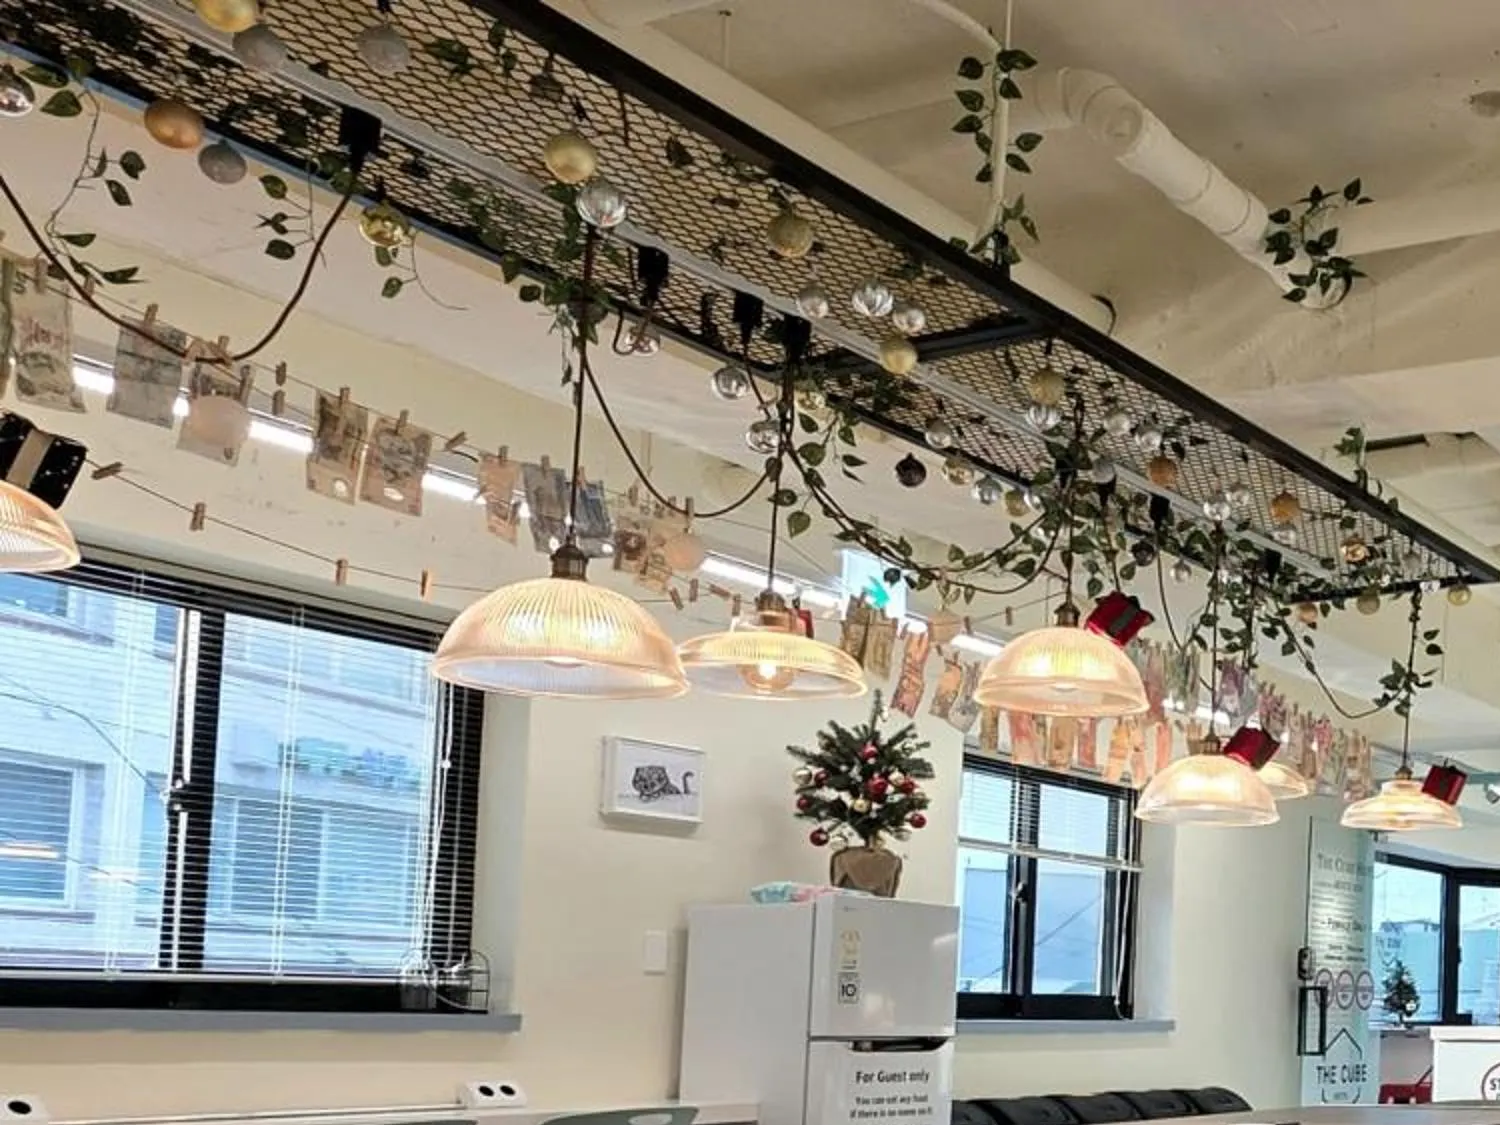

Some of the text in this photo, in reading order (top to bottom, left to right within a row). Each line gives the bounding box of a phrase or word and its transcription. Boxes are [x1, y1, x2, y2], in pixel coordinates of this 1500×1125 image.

[855, 1068, 930, 1084] For Guest only
[1316, 1064, 1367, 1084] THE CUBE
